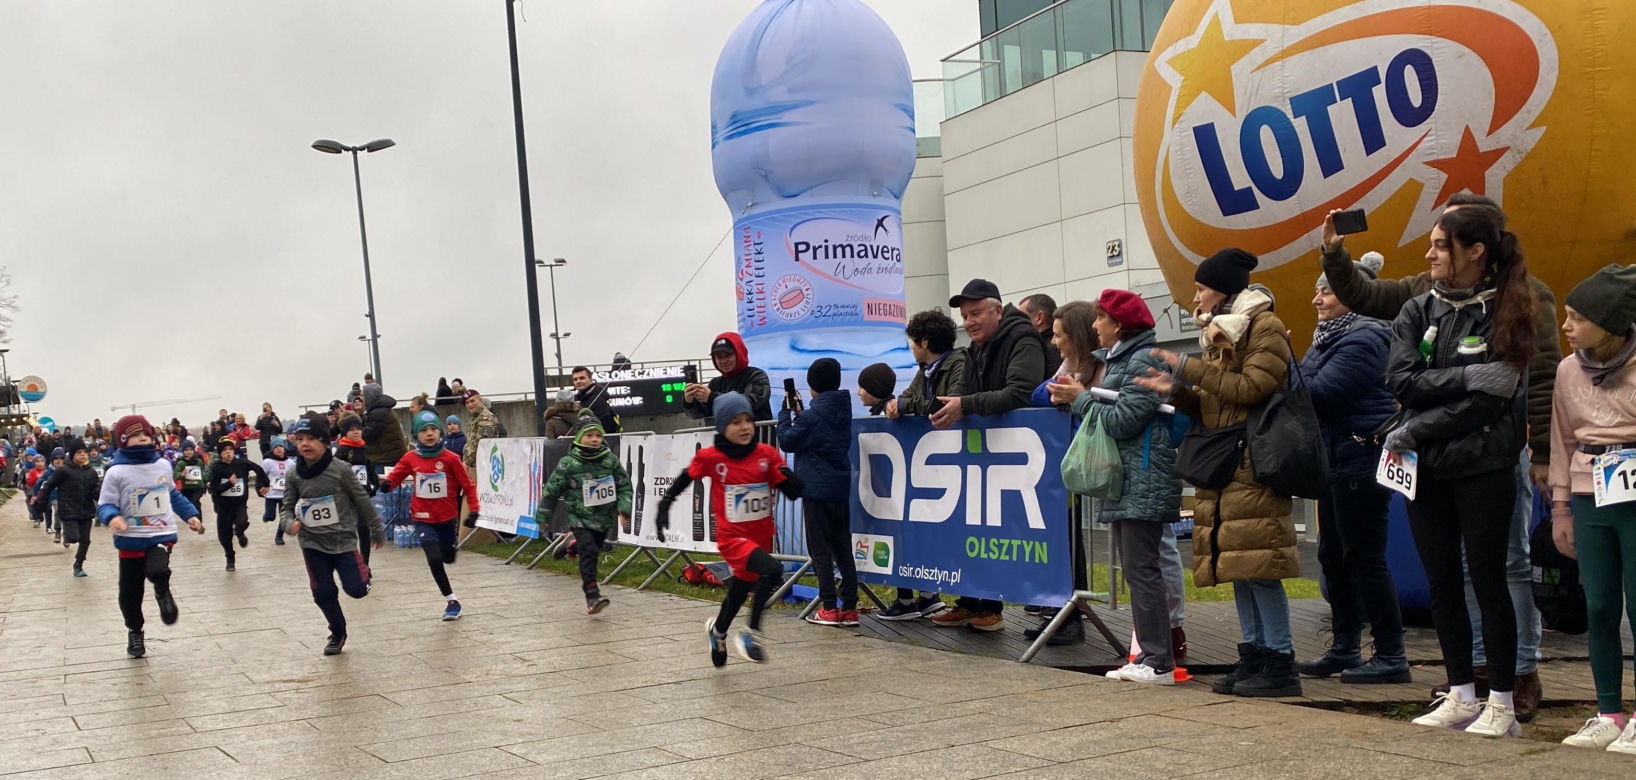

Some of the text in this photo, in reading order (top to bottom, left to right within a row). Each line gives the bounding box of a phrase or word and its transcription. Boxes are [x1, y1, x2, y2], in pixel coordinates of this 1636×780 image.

[1192, 47, 1439, 217] LOTTO
[743, 226, 754, 277] ZMIANA
[793, 239, 901, 263] Primavera
[1106, 242, 1120, 257] 23
[833, 260, 874, 280] Woda
[753, 241, 768, 326] WIELKI EFEKT
[814, 304, 832, 318] 32
[592, 366, 686, 382] ASŁONECZNIENIE
[715, 463, 728, 482] 9
[1387, 462, 1412, 490] 699
[428, 482, 441, 493] 16
[595, 485, 614, 500] 106
[154, 496, 160, 508] 1
[743, 496, 769, 513] 103
[312, 507, 331, 521] 83
[965, 536, 1048, 564] OLSZTYN
[898, 563, 961, 586] osir.olsztyn.pl
